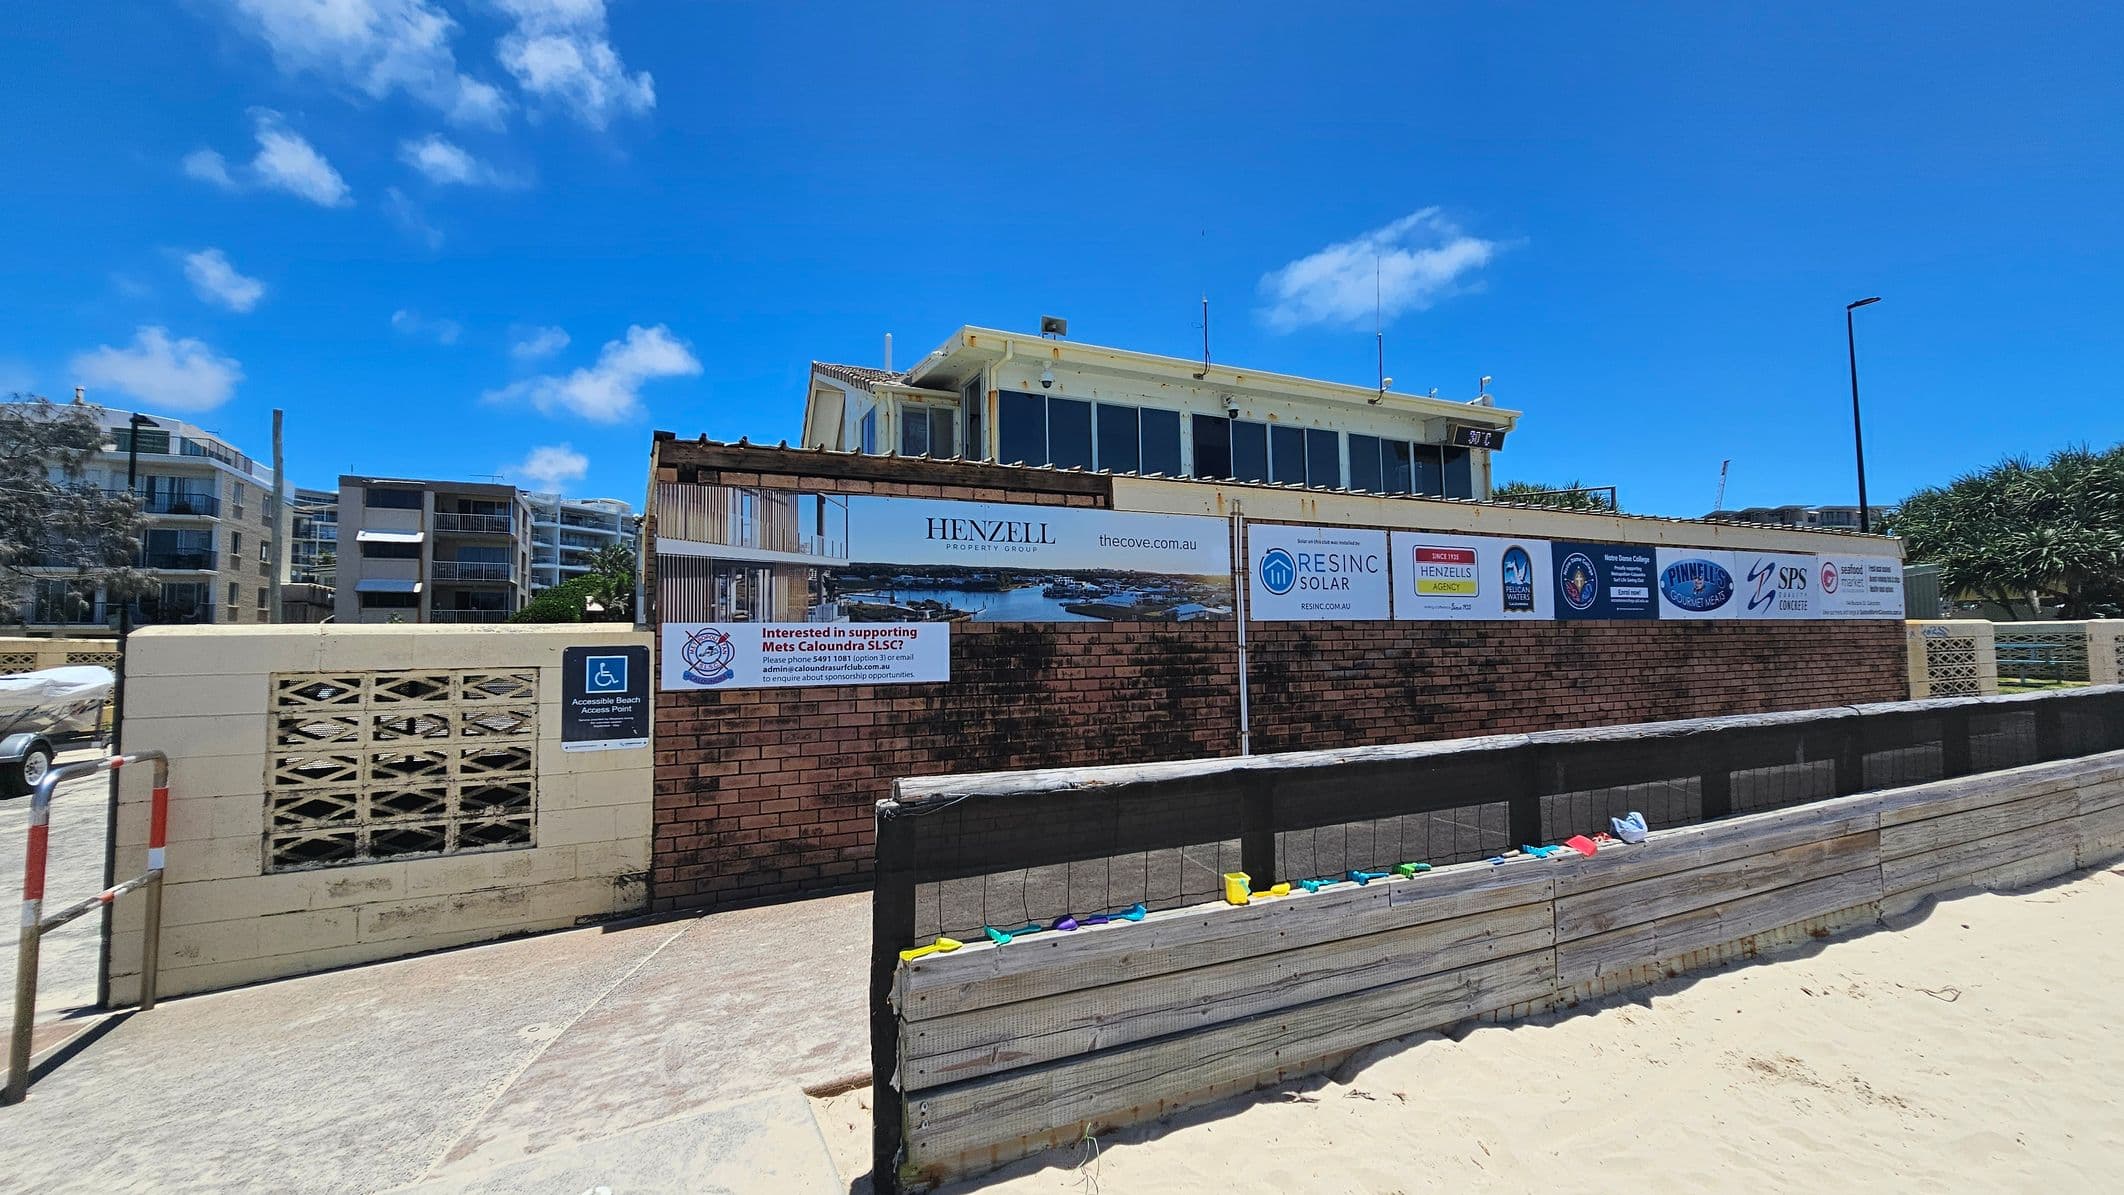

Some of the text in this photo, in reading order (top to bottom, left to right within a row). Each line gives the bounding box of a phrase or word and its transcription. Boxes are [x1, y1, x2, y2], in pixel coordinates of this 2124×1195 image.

[926, 517, 1056, 545] HENZELL
[1099, 534, 1197, 550] thecove.com.au
[946, 543, 1038, 553] PROPERTY GROUP
[1432, 552, 1447, 560] SINCE
[1632, 555, 1650, 564] College
[1298, 553, 1378, 574] RESINC
[1420, 566, 1472, 578] HENZELLS
[1841, 564, 1864, 575] seafood
[1667, 562, 1726, 589] PINNELL'S
[1778, 566, 1808, 590] SPS
[1300, 576, 1350, 591] SOLAR
[1432, 582, 1460, 591] AGENCY
[1841, 576, 1865, 587] market
[1507, 593, 1530, 601] WATERS
[1670, 590, 1726, 608] GOURMET MEATS
[1779, 600, 1808, 611] CONCRETE
[762, 626, 918, 640] Interested in supporting
[762, 640, 904, 652] Mets Caloundra SLSC?
[762, 656, 787, 664] Please
[788, 656, 812, 665] phone
[853, 655, 878, 663] (option
[880, 654, 886, 662] 3)
[762, 663, 890, 673] admin@caloundrasurfclub.com.au
[772, 675, 800, 683] enquire
[824, 672, 867, 681] sponsorship
[571, 696, 641, 705] Accessible Beach
[581, 705, 633, 714] Access Point
